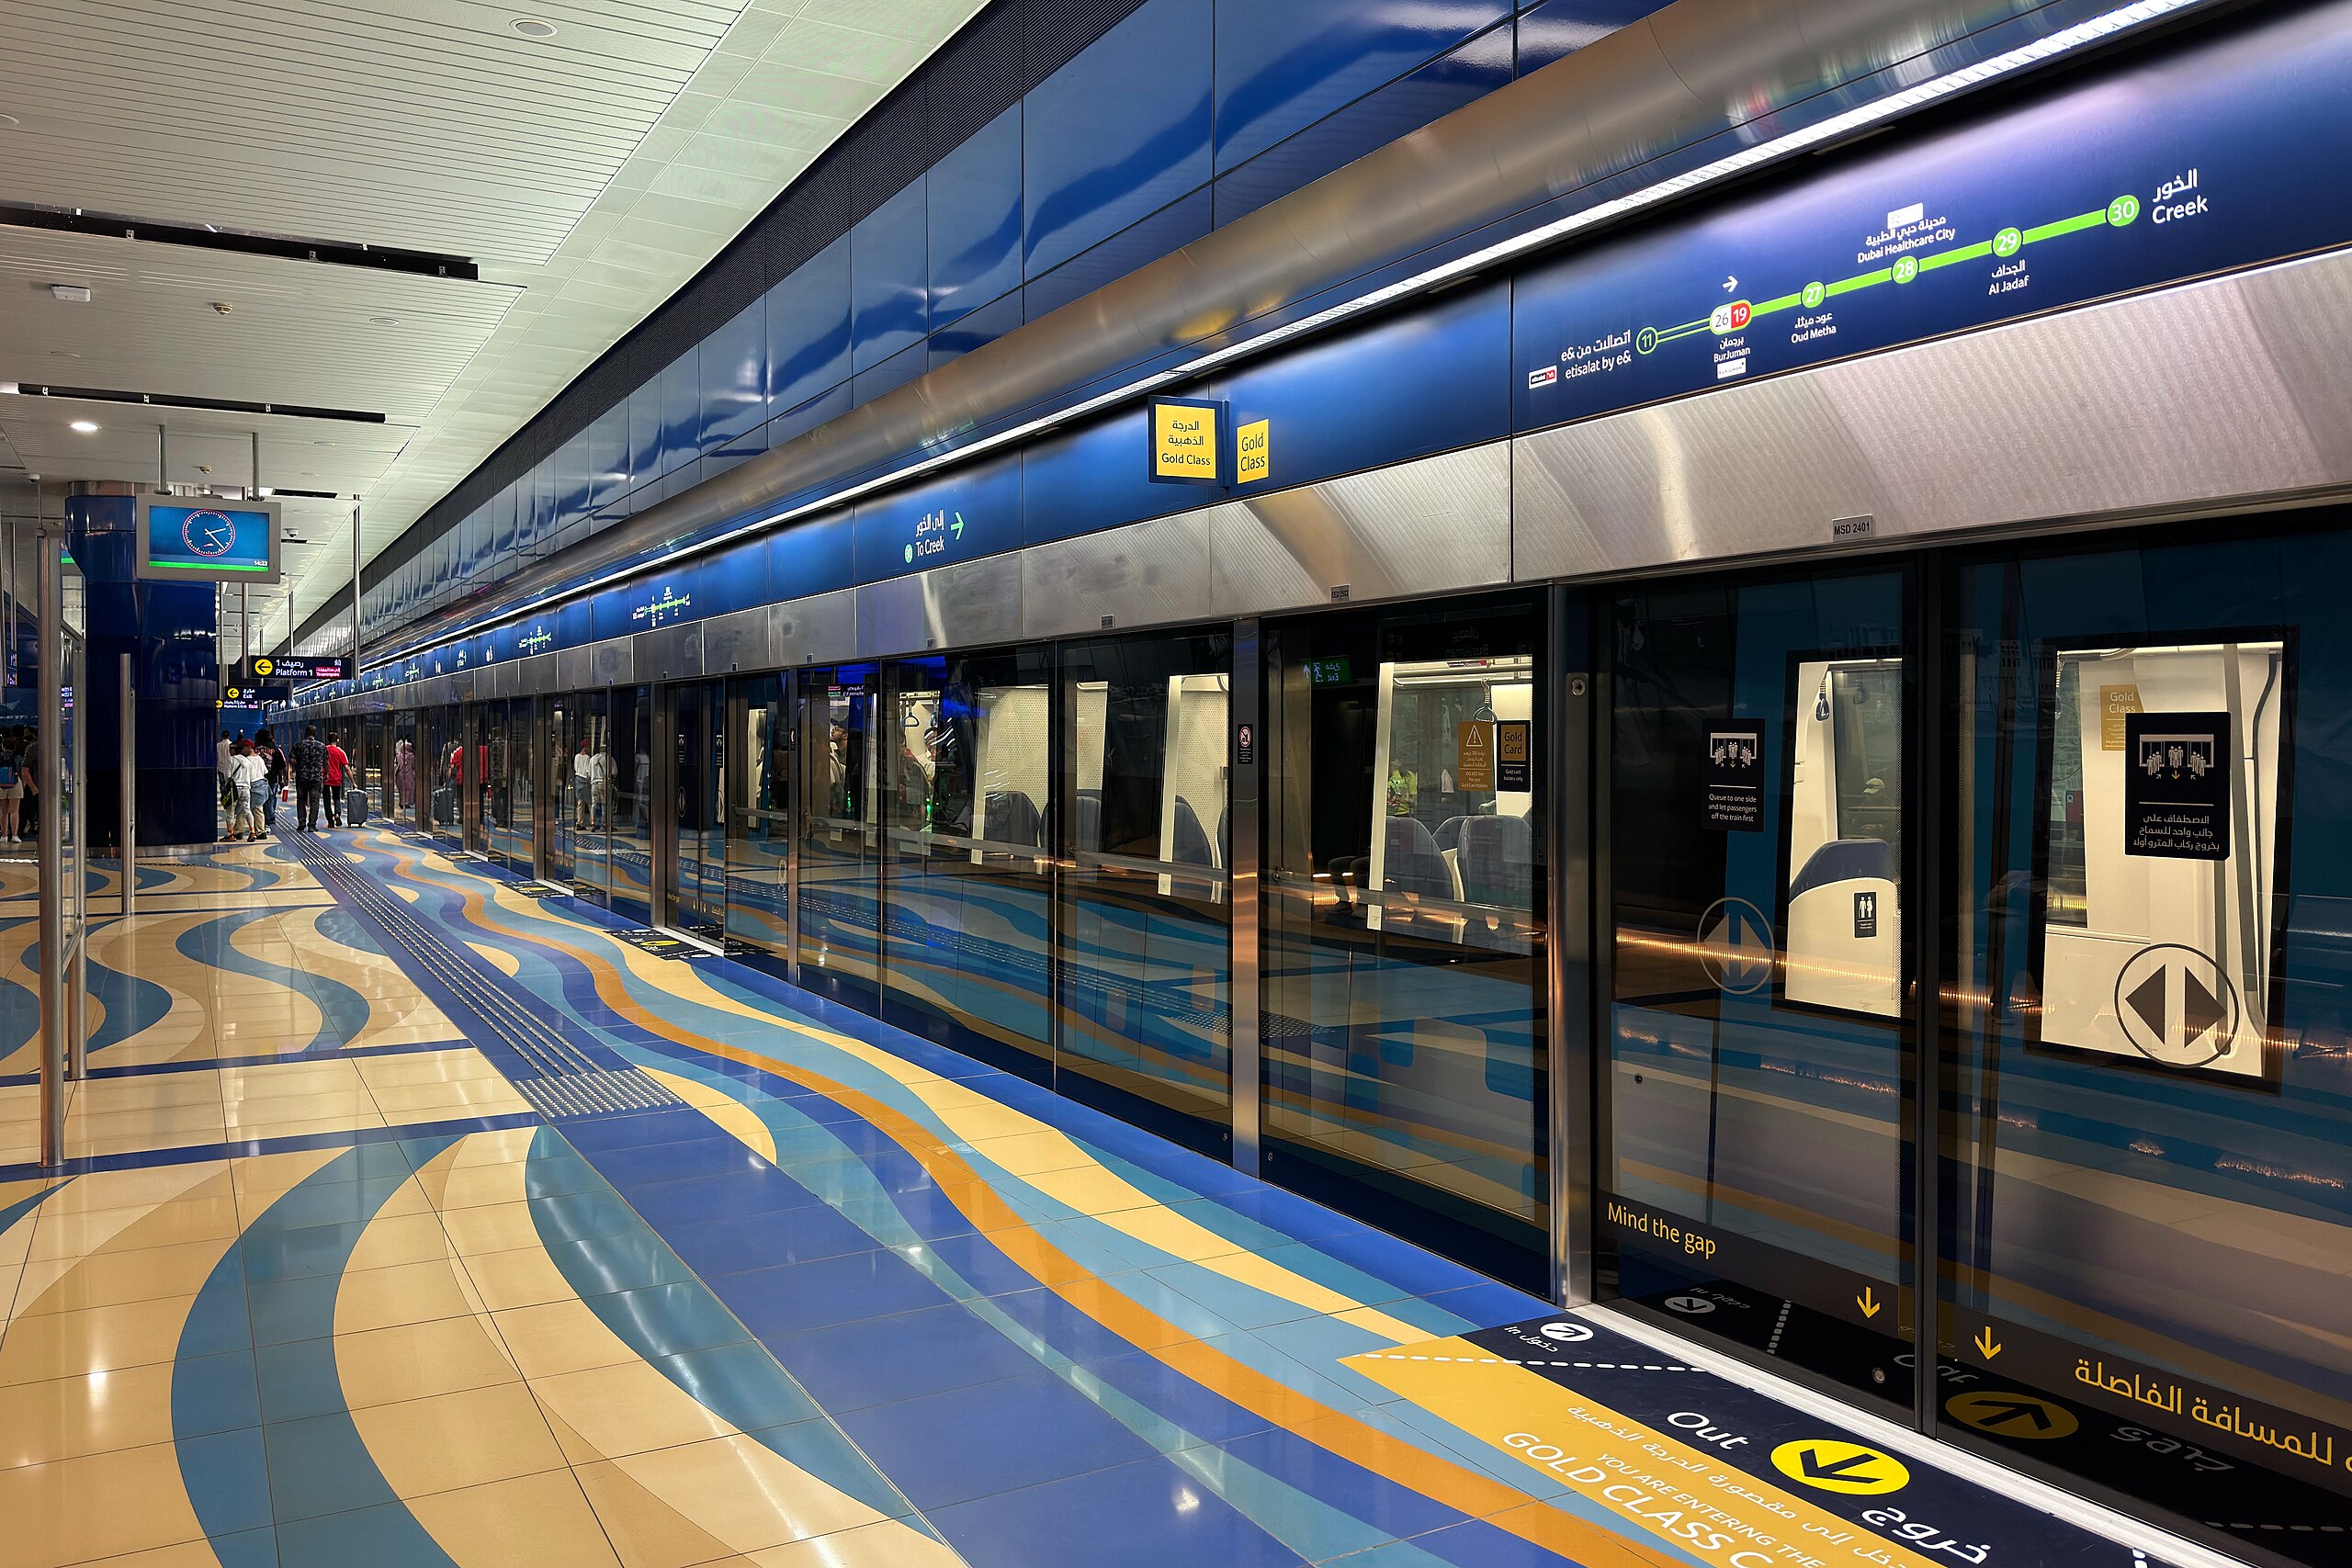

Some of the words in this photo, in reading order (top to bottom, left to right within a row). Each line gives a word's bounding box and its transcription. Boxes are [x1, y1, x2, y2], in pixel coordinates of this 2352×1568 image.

[2152, 168, 2198, 203] الخور
[2111, 200, 2135, 221] 30
[2152, 195, 2209, 224] Creek
[1896, 223, 1917, 241] دبي
[1918, 216, 1947, 231] مدينة
[1866, 227, 1895, 246] الطبية
[1996, 232, 2018, 252] 29
[1857, 247, 1883, 264] Dubai
[1885, 233, 1934, 256] Healthcare
[1936, 228, 1956, 242] City
[1895, 261, 1915, 279] 28
[1991, 259, 2026, 278] الجداف
[1988, 282, 2000, 296] Al
[2001, 276, 2030, 292] Jadaf
[1805, 286, 1822, 304] 27
[1714, 313, 1729, 328] 26
[1733, 306, 1747, 323] 19
[1794, 316, 1815, 329] ميثاء
[1815, 312, 1833, 324] عود
[1593, 329, 1631, 352] اتصالات
[1641, 333, 1653, 348] 11
[1792, 330, 1809, 344] Oud
[1810, 324, 1837, 339] Metha
[1577, 344, 1591, 359] من
[1719, 336, 1745, 350] برجمان
[1561, 346, 1576, 362] e&
[1713, 346, 1751, 363] BurJuman
[1565, 359, 1600, 379] etisalat
[1601, 355, 1615, 372] by
[1617, 350, 1632, 366] e&
[1171, 420, 1200, 432] الدرجة
[1168, 434, 1204, 446] الذهبية
[1241, 432, 1264, 452] Gold
[1161, 453, 1184, 464] Gold
[1186, 454, 1211, 466] Class
[1240, 456, 1265, 472] Class
[915, 513, 932, 537] الخور
[932, 509, 944, 531] إلى
[1834, 525, 1851, 536] MSD
[1852, 522, 1870, 533] 2401
[915, 541, 924, 557] To
[924, 535, 945, 555] Creek
[276, 668, 308, 676] Platform
[281, 660, 304, 669] رصيف
[2109, 691, 2134, 702] Gold
[2109, 703, 2136, 713] Class
[1504, 731, 1522, 742] Gold
[1504, 743, 1522, 755] Card
[1708, 793, 1727, 802] Queue
[1745, 795, 1757, 803] side
[1711, 812, 1719, 820] off
[1719, 812, 1729, 820] the
[1742, 814, 1755, 822] first
[1726, 805, 1758, 814] passengers
[2143, 813, 2164, 824] على
[2163, 814, 2210, 825] الاصطفاف
[2139, 825, 2171, 836] للسماح
[2172, 825, 2191, 838] واحد
[2192, 827, 2213, 838] جانب
[2148, 837, 2174, 849] المترو
[2174, 837, 2194, 850] ركاب
[2194, 840, 2220, 852] بخروج
[1608, 1201, 1648, 1233] Mind
[1653, 1218, 1680, 1244] the
[1684, 1232, 1716, 1260] gap
[1504, 1325, 1521, 1335] In
[1519, 1335, 1558, 1352] دخول
[2075, 1359, 2182, 1416] الفاصلة
[1566, 1406, 1645, 1442] الذهبية
[1667, 1412, 1749, 1450] Out
[2191, 1396, 2333, 1466] للمسافة
[1642, 1443, 1711, 1473] الدرجة
[1502, 1432, 1607, 1483] GOLD
[1602, 1484, 1736, 1551] CLASS
[1707, 1474, 1797, 1519] مقصورة
[1595, 1453, 1641, 1475] YOU
[1633, 1474, 1679, 1495] ARE
[1670, 1493, 1778, 1547] ENTERING
[1776, 1543, 1827, 1568] THE
[1802, 1522, 1855, 1546] إلى
[1861, 1506, 1992, 1565] خروج
